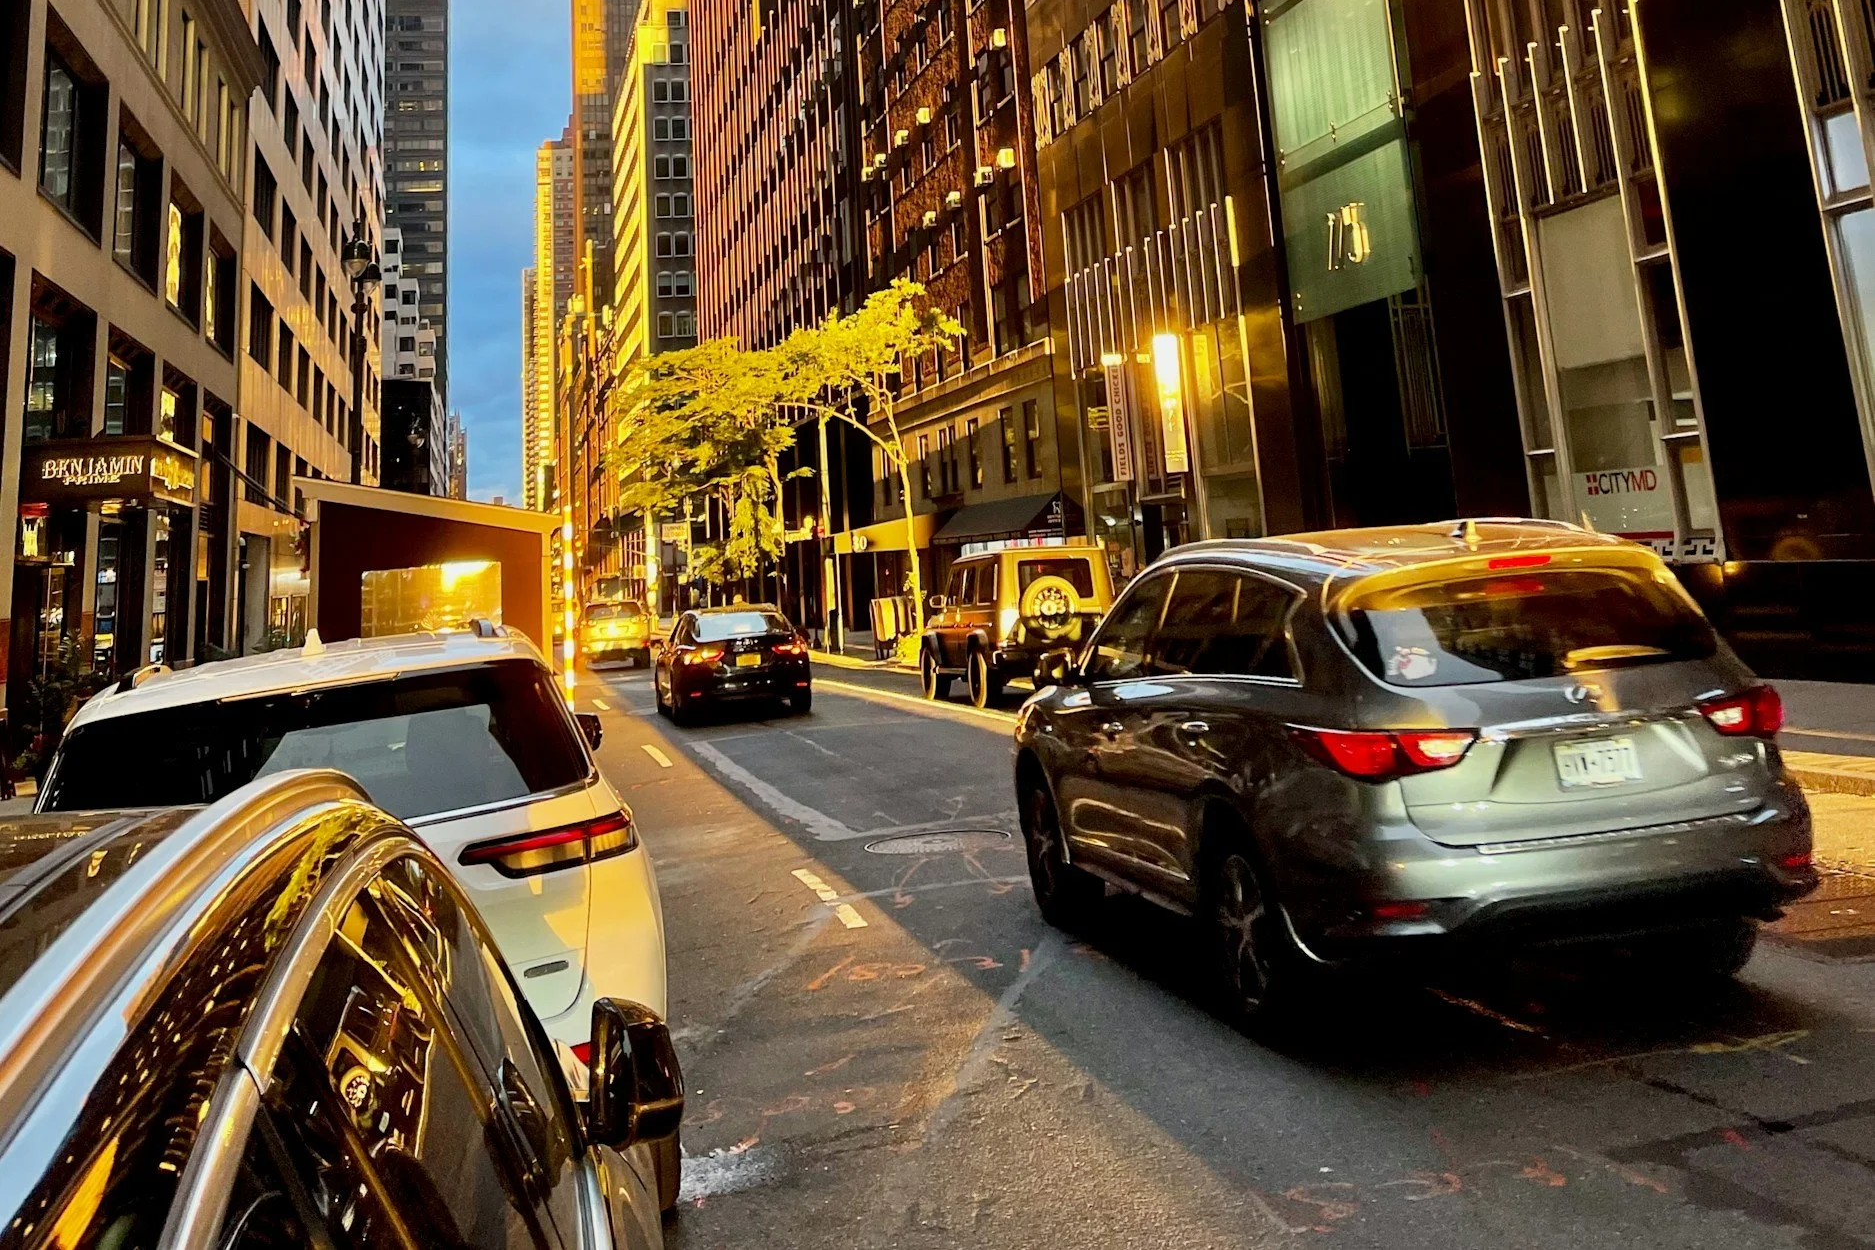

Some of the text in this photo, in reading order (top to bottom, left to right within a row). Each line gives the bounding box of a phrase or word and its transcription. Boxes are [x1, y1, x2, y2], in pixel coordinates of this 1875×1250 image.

[1115, 408, 1124, 437] GOOD
[42, 455, 144, 479] BENJAMIN
[1120, 442, 1128, 476] FIELDS
[62, 475, 120, 485] PRIME
[1599, 469, 1657, 495] CITYMD
